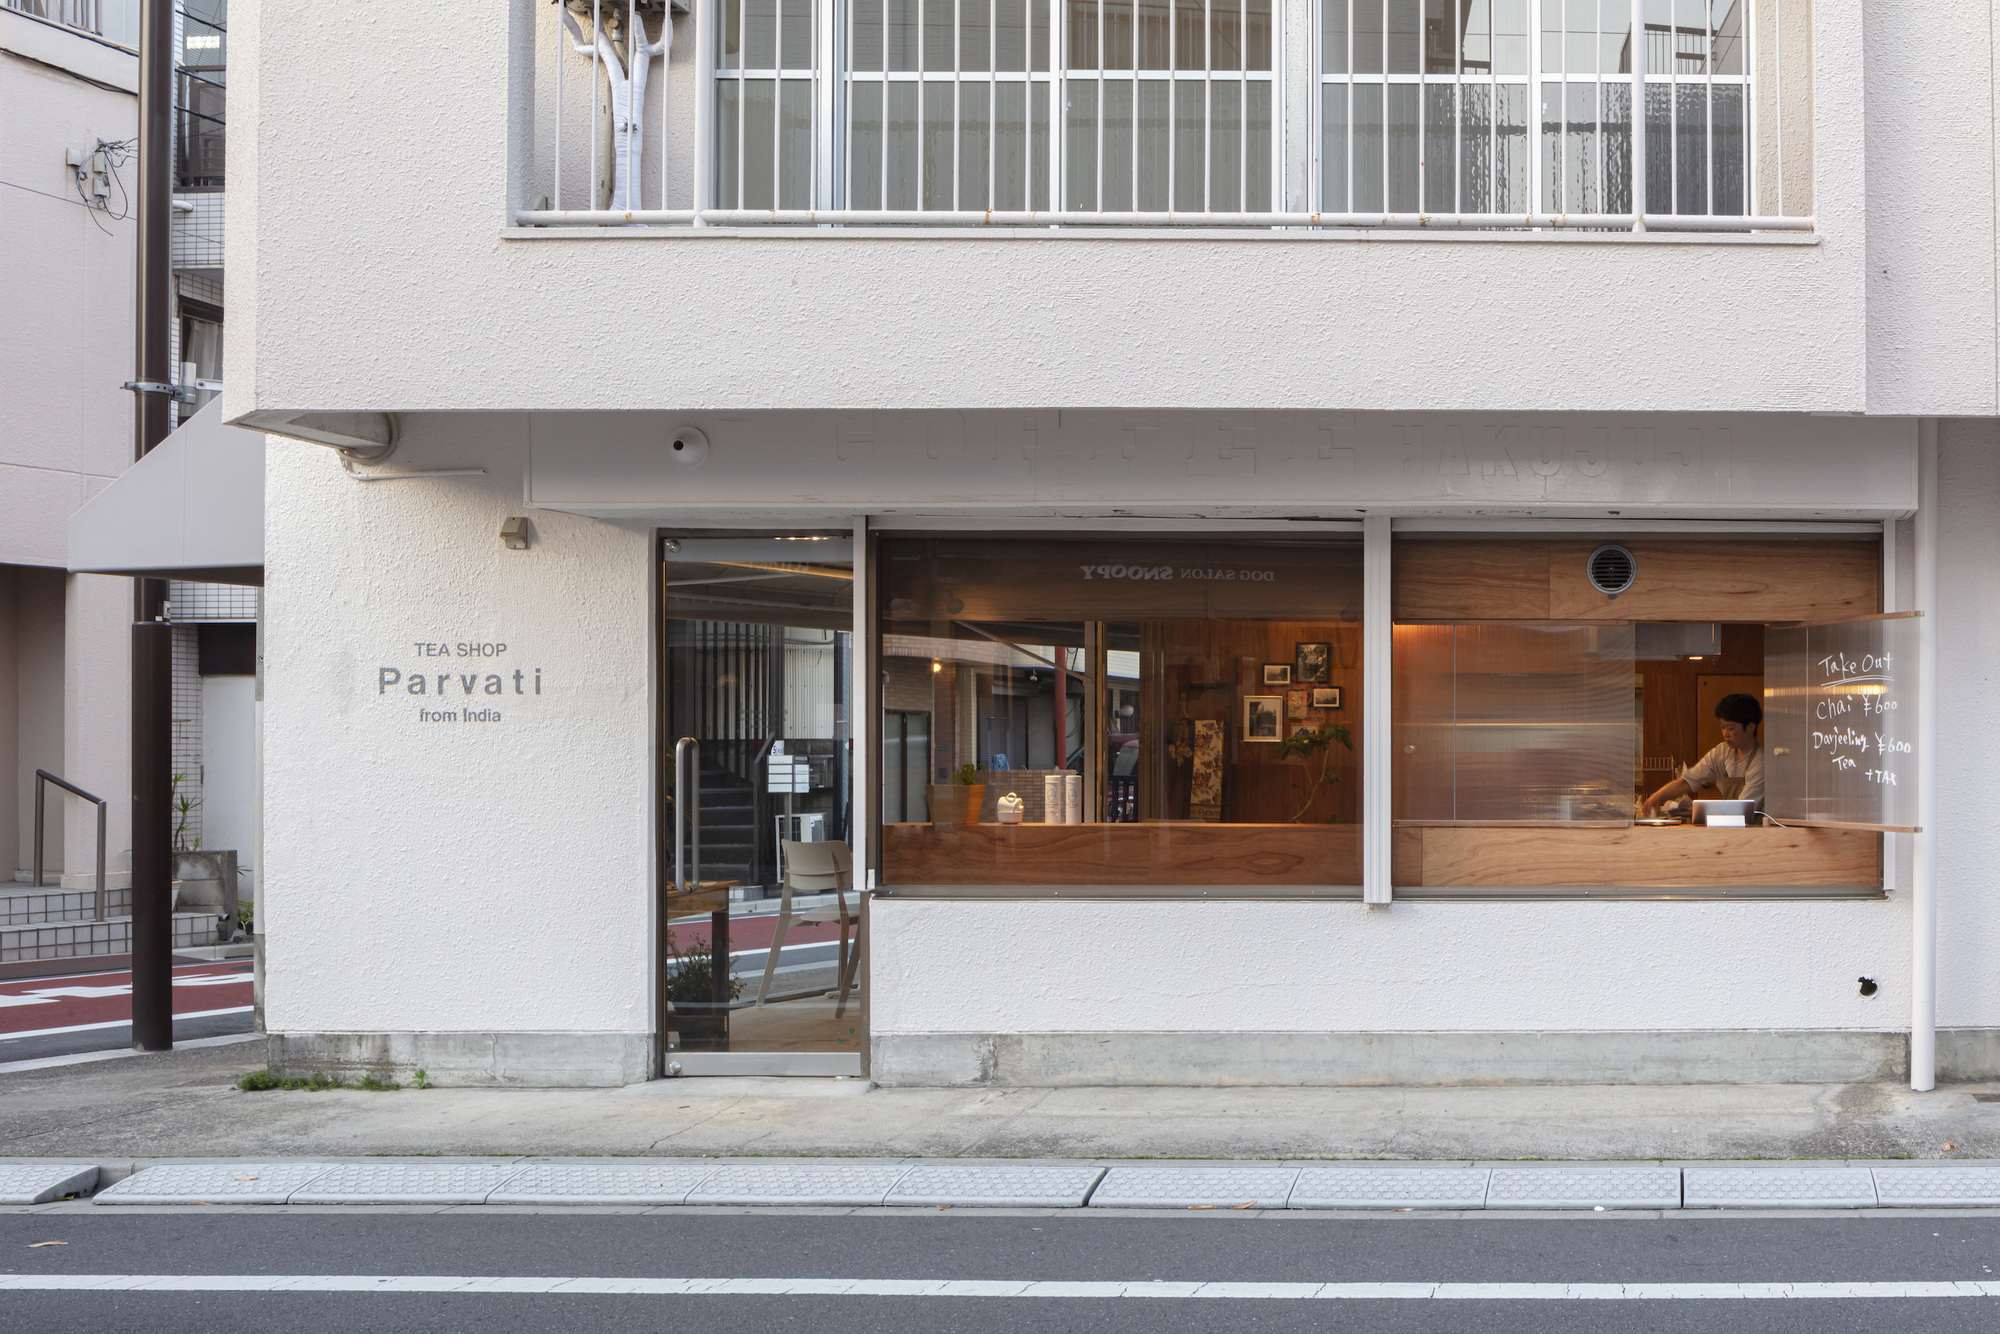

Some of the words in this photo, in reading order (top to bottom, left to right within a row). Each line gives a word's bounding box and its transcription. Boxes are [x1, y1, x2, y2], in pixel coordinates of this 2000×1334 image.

[414, 643, 450, 657] TEA
[456, 643, 507, 657] SHOP
[1818, 652, 1856, 679] Take
[1862, 652, 1894, 673] Out
[379, 667, 541, 695] Parvati
[420, 708, 457, 722] from
[463, 708, 501, 722] India
[1816, 695, 1852, 719] Chai
[1861, 691, 1898, 717] ¥600
[1812, 726, 1869, 755] Darjeeling
[1874, 732, 1911, 755] ¥600
[1832, 755, 1856, 770] Tea
